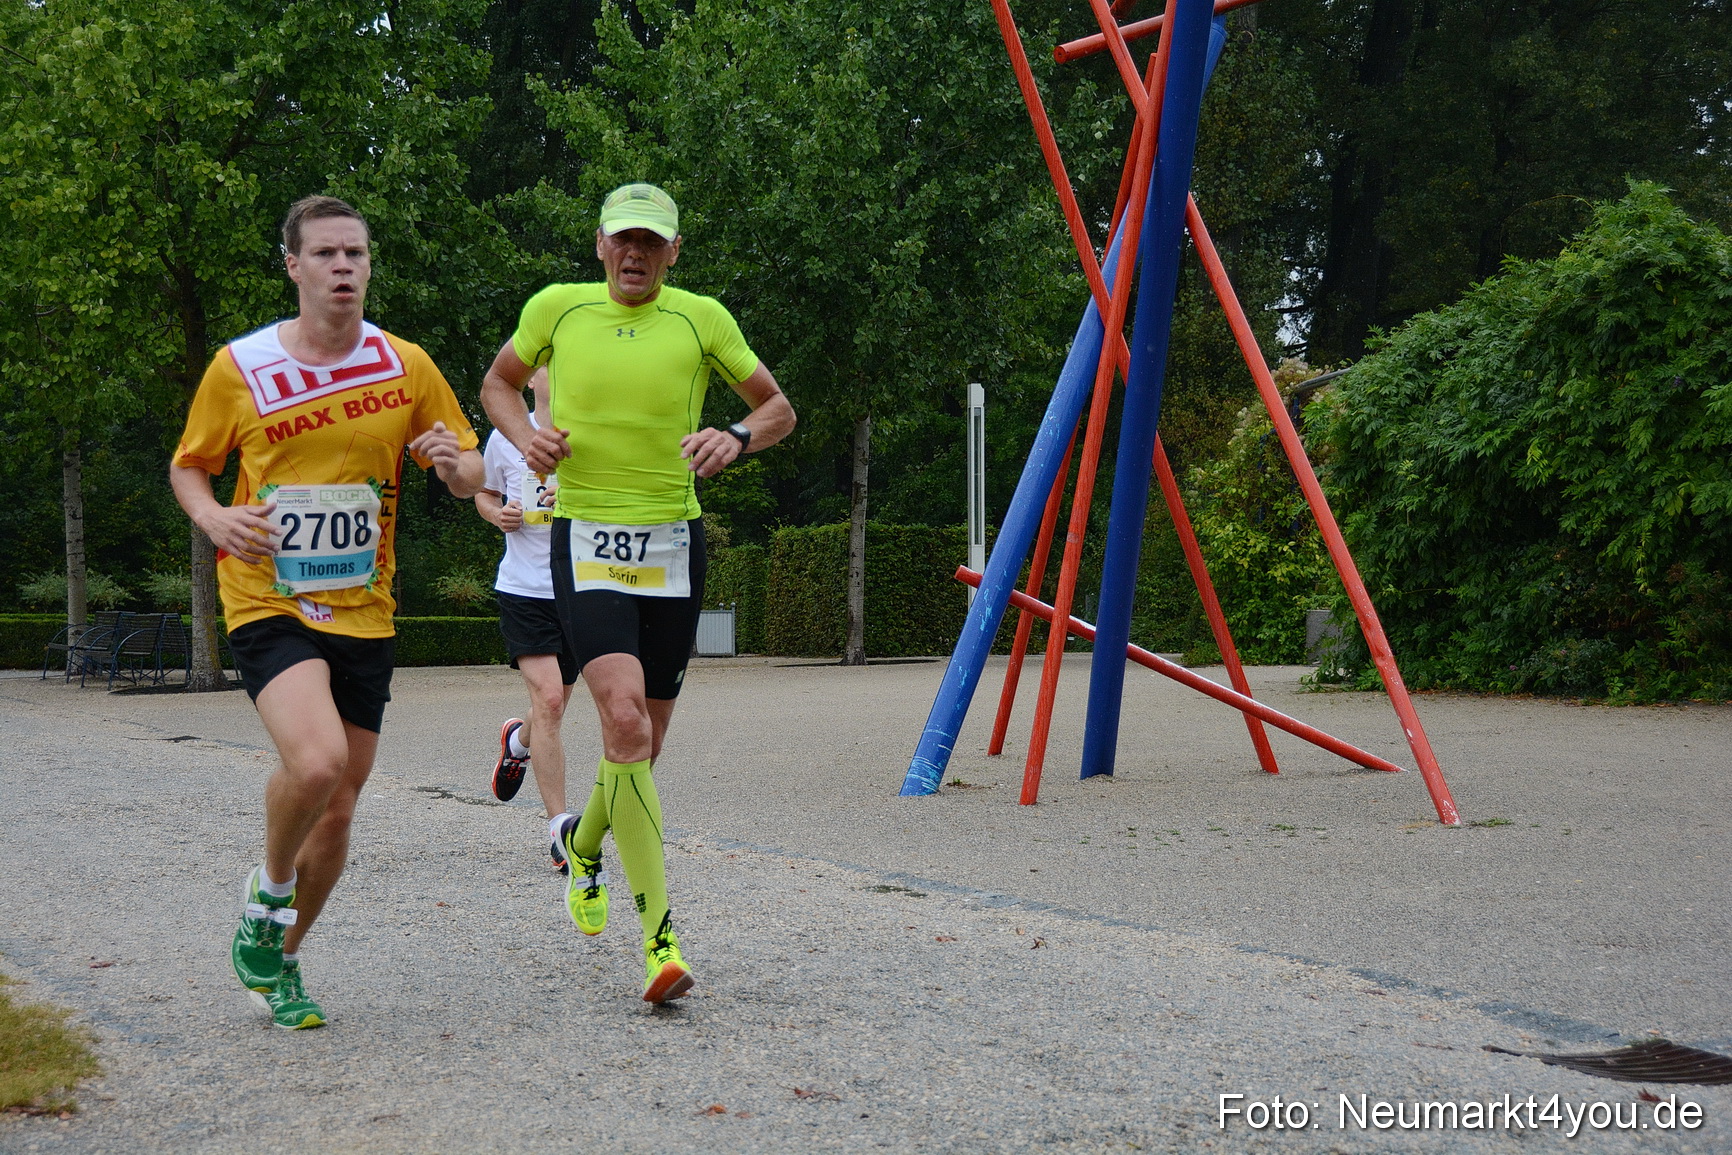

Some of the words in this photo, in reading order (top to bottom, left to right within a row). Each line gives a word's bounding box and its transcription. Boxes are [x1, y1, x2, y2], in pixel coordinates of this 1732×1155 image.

[264, 407, 337, 445] MAX
[342, 388, 413, 420] BÖGL
[319, 489, 372, 502] BOCK
[280, 511, 372, 551] 2708
[593, 530, 652, 562] 287
[298, 561, 355, 577] Thomas
